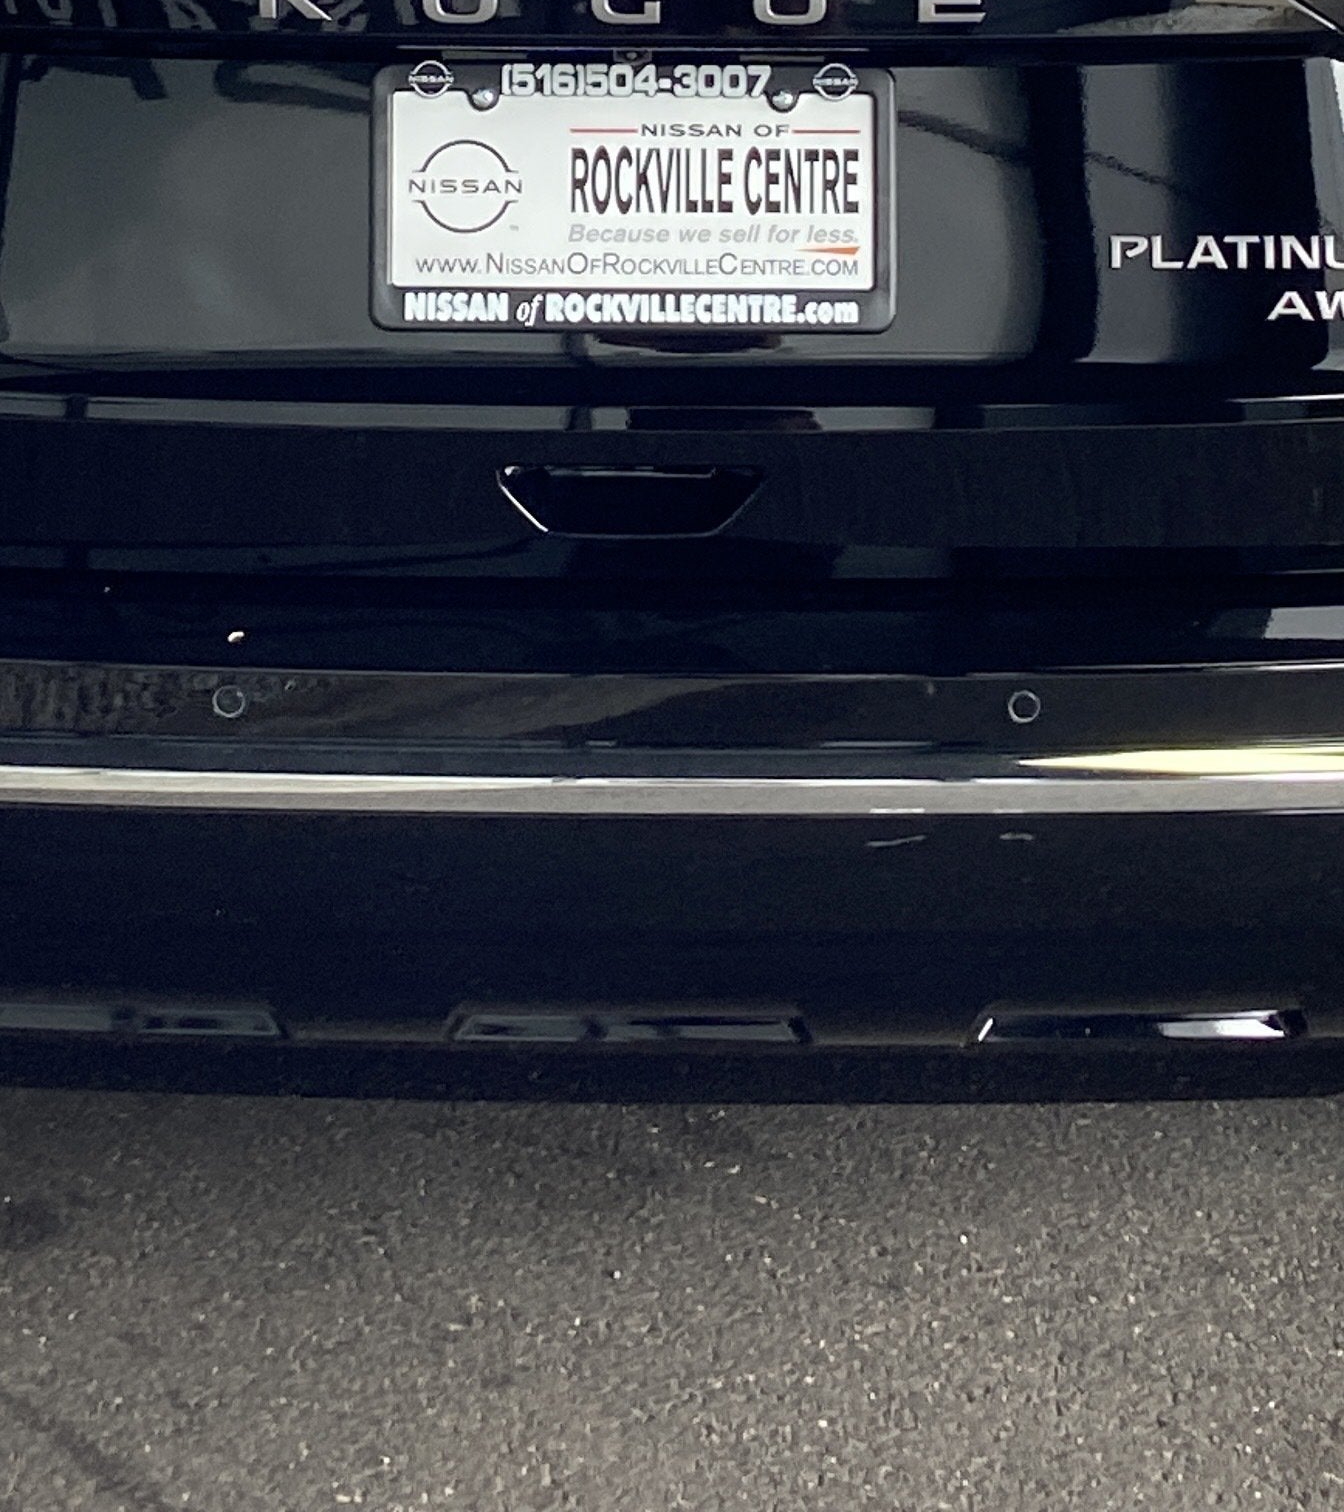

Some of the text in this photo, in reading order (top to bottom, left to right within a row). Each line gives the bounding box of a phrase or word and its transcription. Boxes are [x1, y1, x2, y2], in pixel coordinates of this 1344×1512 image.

[500, 63, 773, 98] (516)504-3007
[640, 123, 790, 137] NISSAN OF
[409, 178, 522, 194] NISSAN
[570, 145, 860, 216] ROCKVILLE CENTRE
[567, 224, 860, 244] Because we sell for less.
[403, 292, 859, 328] NISSAN of ROCKVILLECENTRE.com
